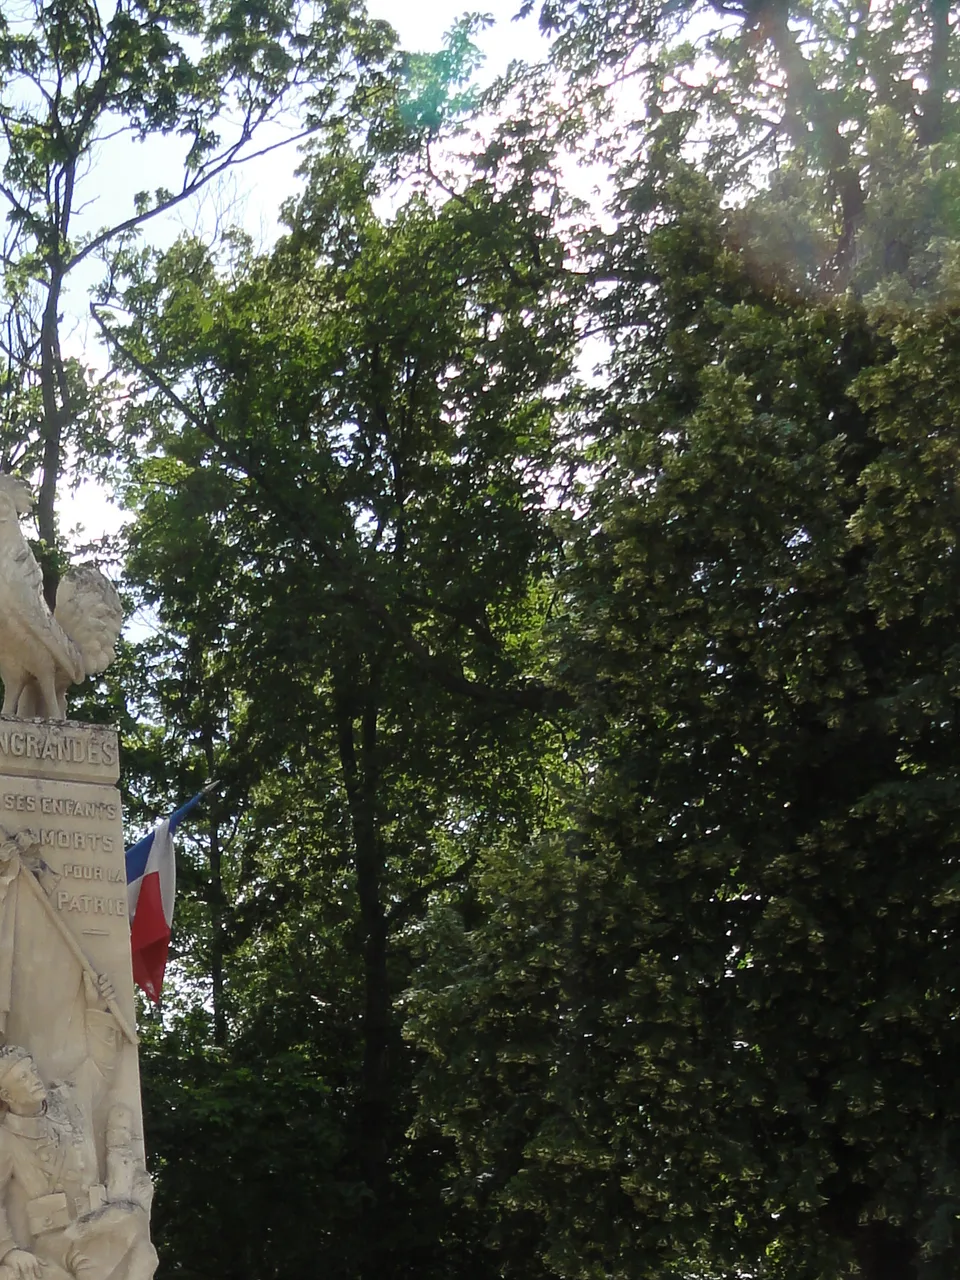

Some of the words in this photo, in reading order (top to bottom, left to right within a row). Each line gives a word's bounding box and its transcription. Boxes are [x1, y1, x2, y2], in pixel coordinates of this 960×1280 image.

[4, 794, 36, 812] SES
[40, 797, 117, 820] ENFANTS
[40, 829, 114, 852] MORTS
[64, 864, 104, 882] POUR
[107, 868, 125, 882] LA
[57, 890, 126, 917] PATRIE
